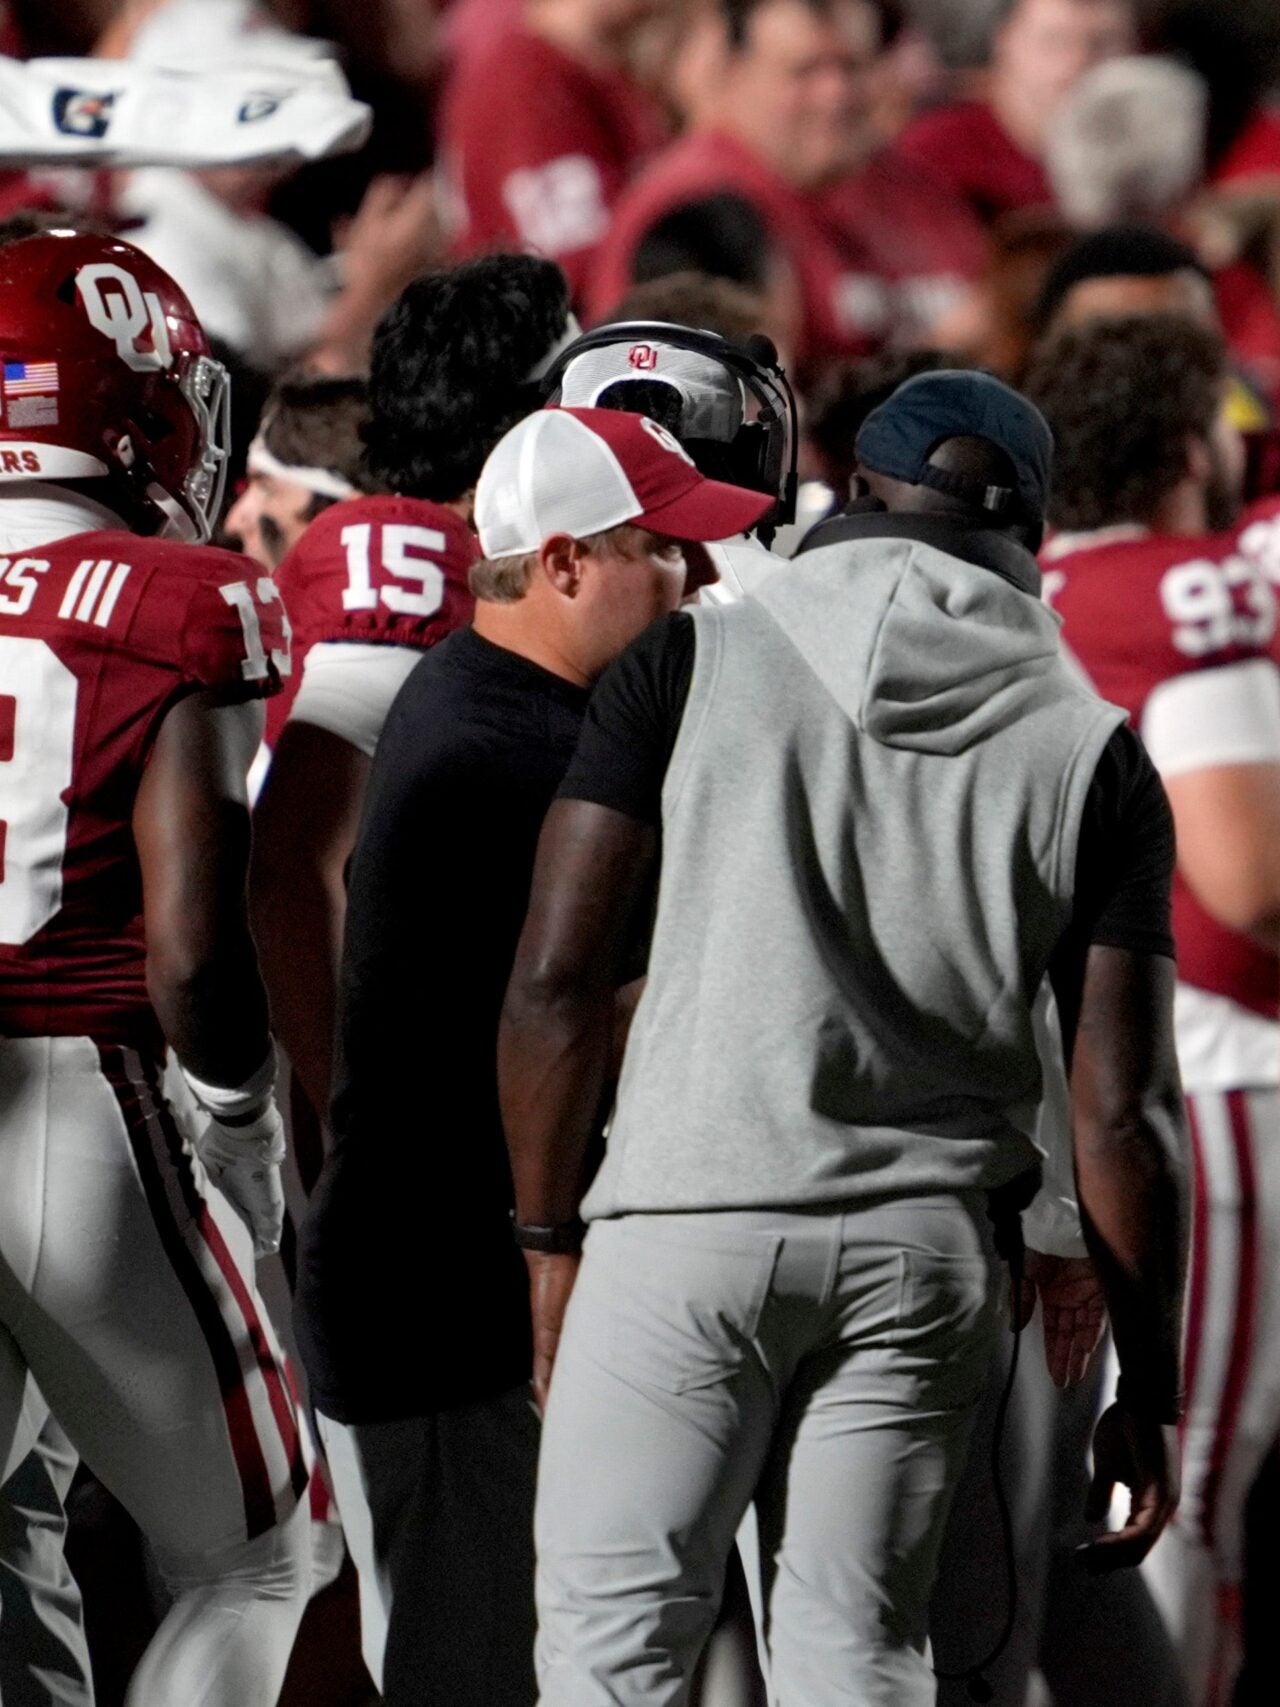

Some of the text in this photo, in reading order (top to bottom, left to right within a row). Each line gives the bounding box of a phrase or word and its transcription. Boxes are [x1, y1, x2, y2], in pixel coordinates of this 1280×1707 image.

[75, 263, 174, 372] OU
[628, 345, 658, 370] OU
[0, 450, 41, 473] RS
[0, 557, 52, 616] S
[341, 522, 446, 618] 15
